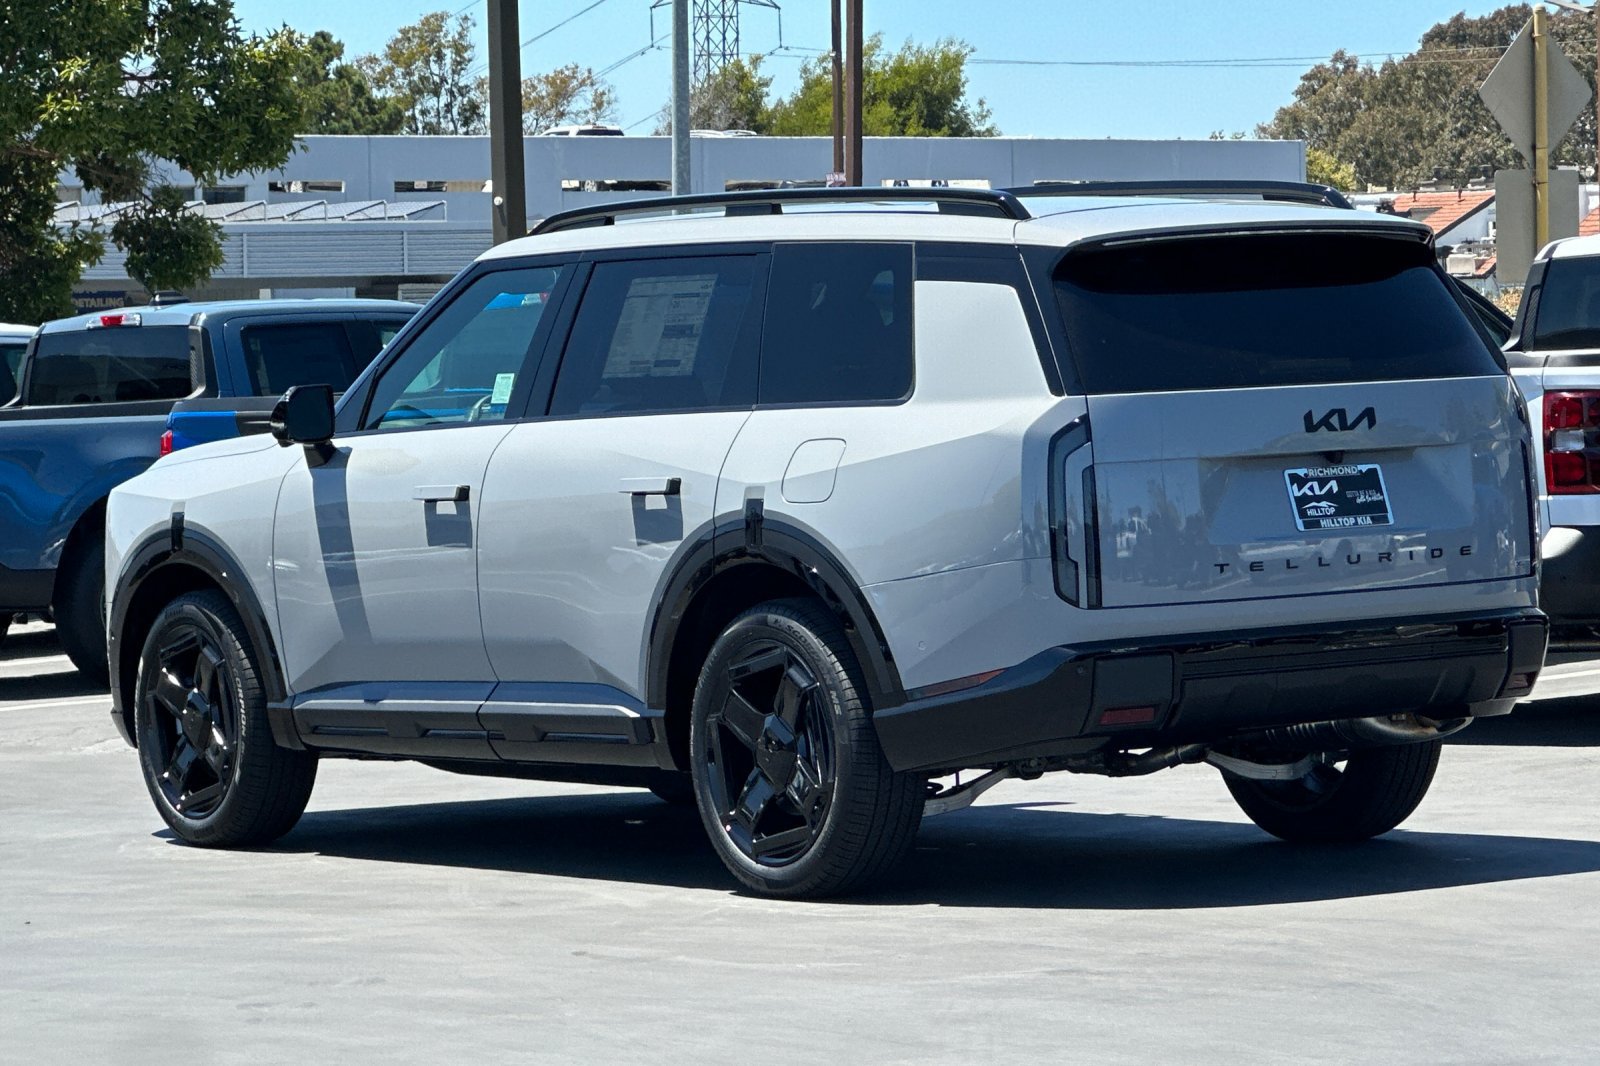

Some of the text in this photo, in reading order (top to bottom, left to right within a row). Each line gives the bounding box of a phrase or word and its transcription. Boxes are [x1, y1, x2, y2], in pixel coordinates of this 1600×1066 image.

[71, 297, 124, 308] DETAILING
[1303, 406, 1377, 433] KIA
[1308, 466, 1358, 477] RICHMOND
[1292, 479, 1339, 497] KIA
[1306, 506, 1336, 516] HILLTOP
[1320, 515, 1373, 528] HILLTOP KIA
[1213, 545, 1472, 574] TELLURIDE
